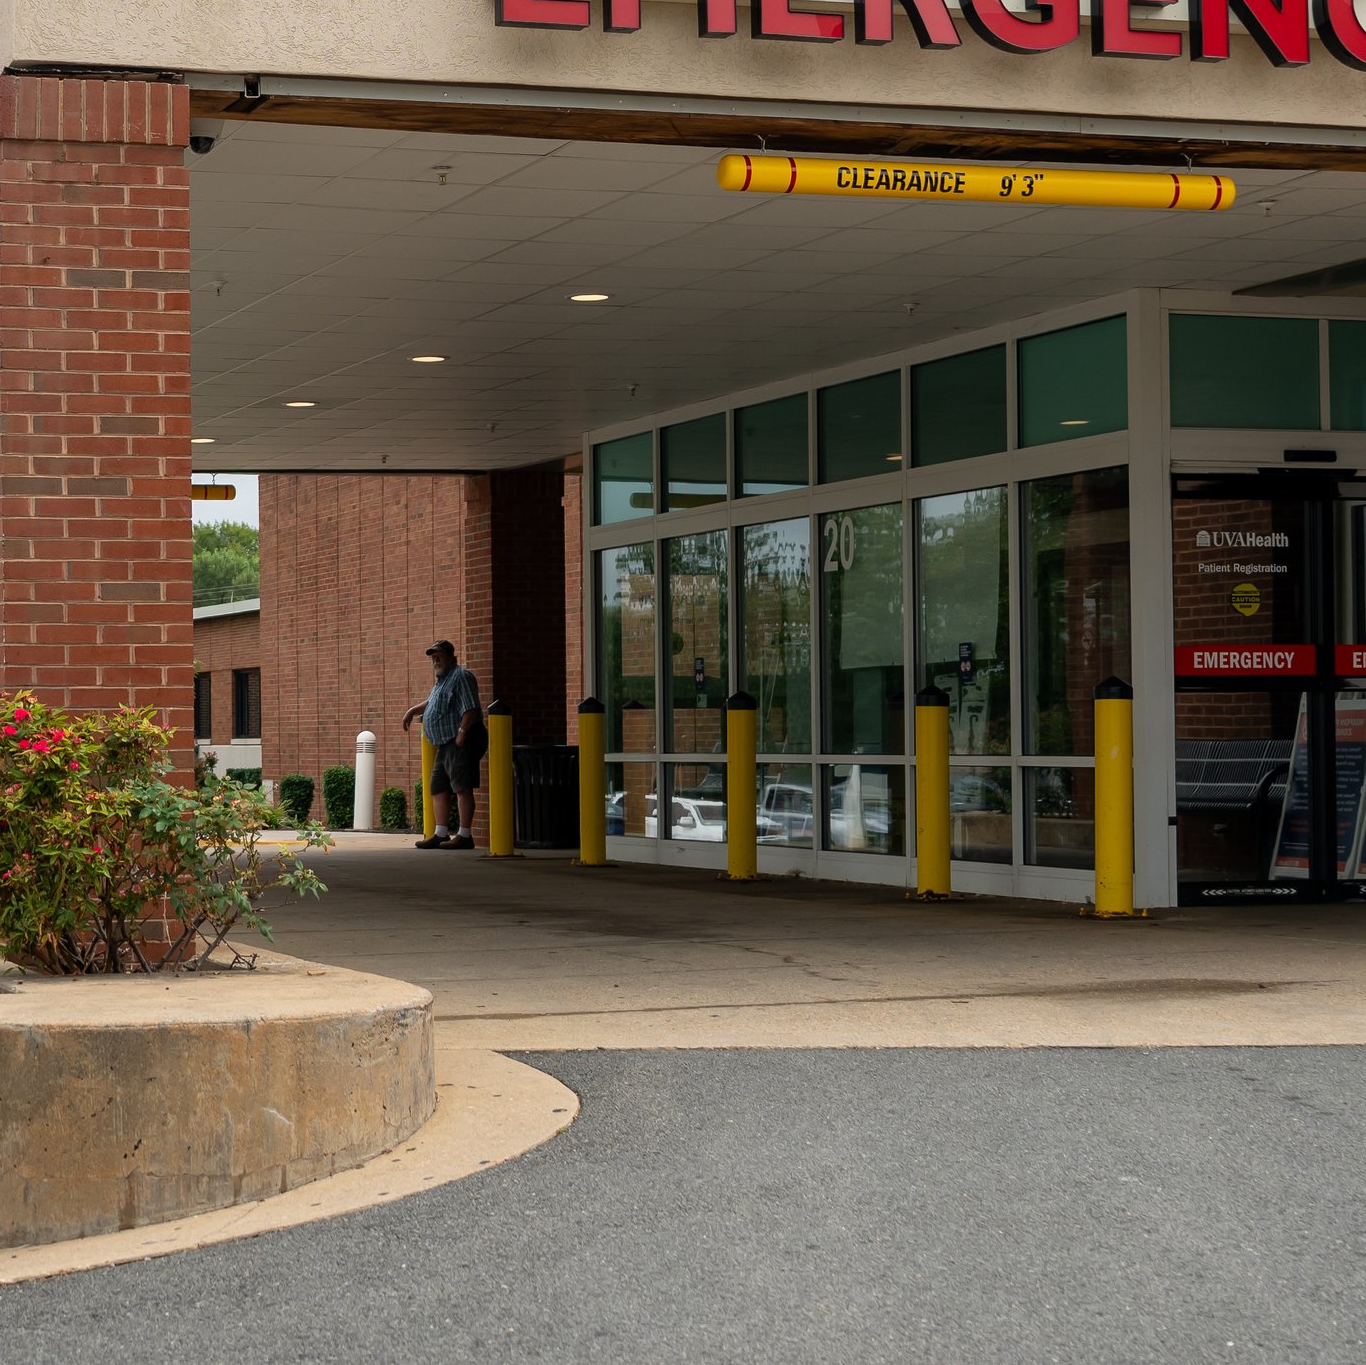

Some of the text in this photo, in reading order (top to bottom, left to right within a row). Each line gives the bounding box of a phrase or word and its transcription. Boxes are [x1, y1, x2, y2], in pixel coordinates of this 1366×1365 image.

[836, 165, 966, 194] CLEARANCE
[823, 515, 855, 572] 20
[1198, 563, 1288, 574] Patient Registration
[1193, 651, 1295, 669] EMERGENCY
